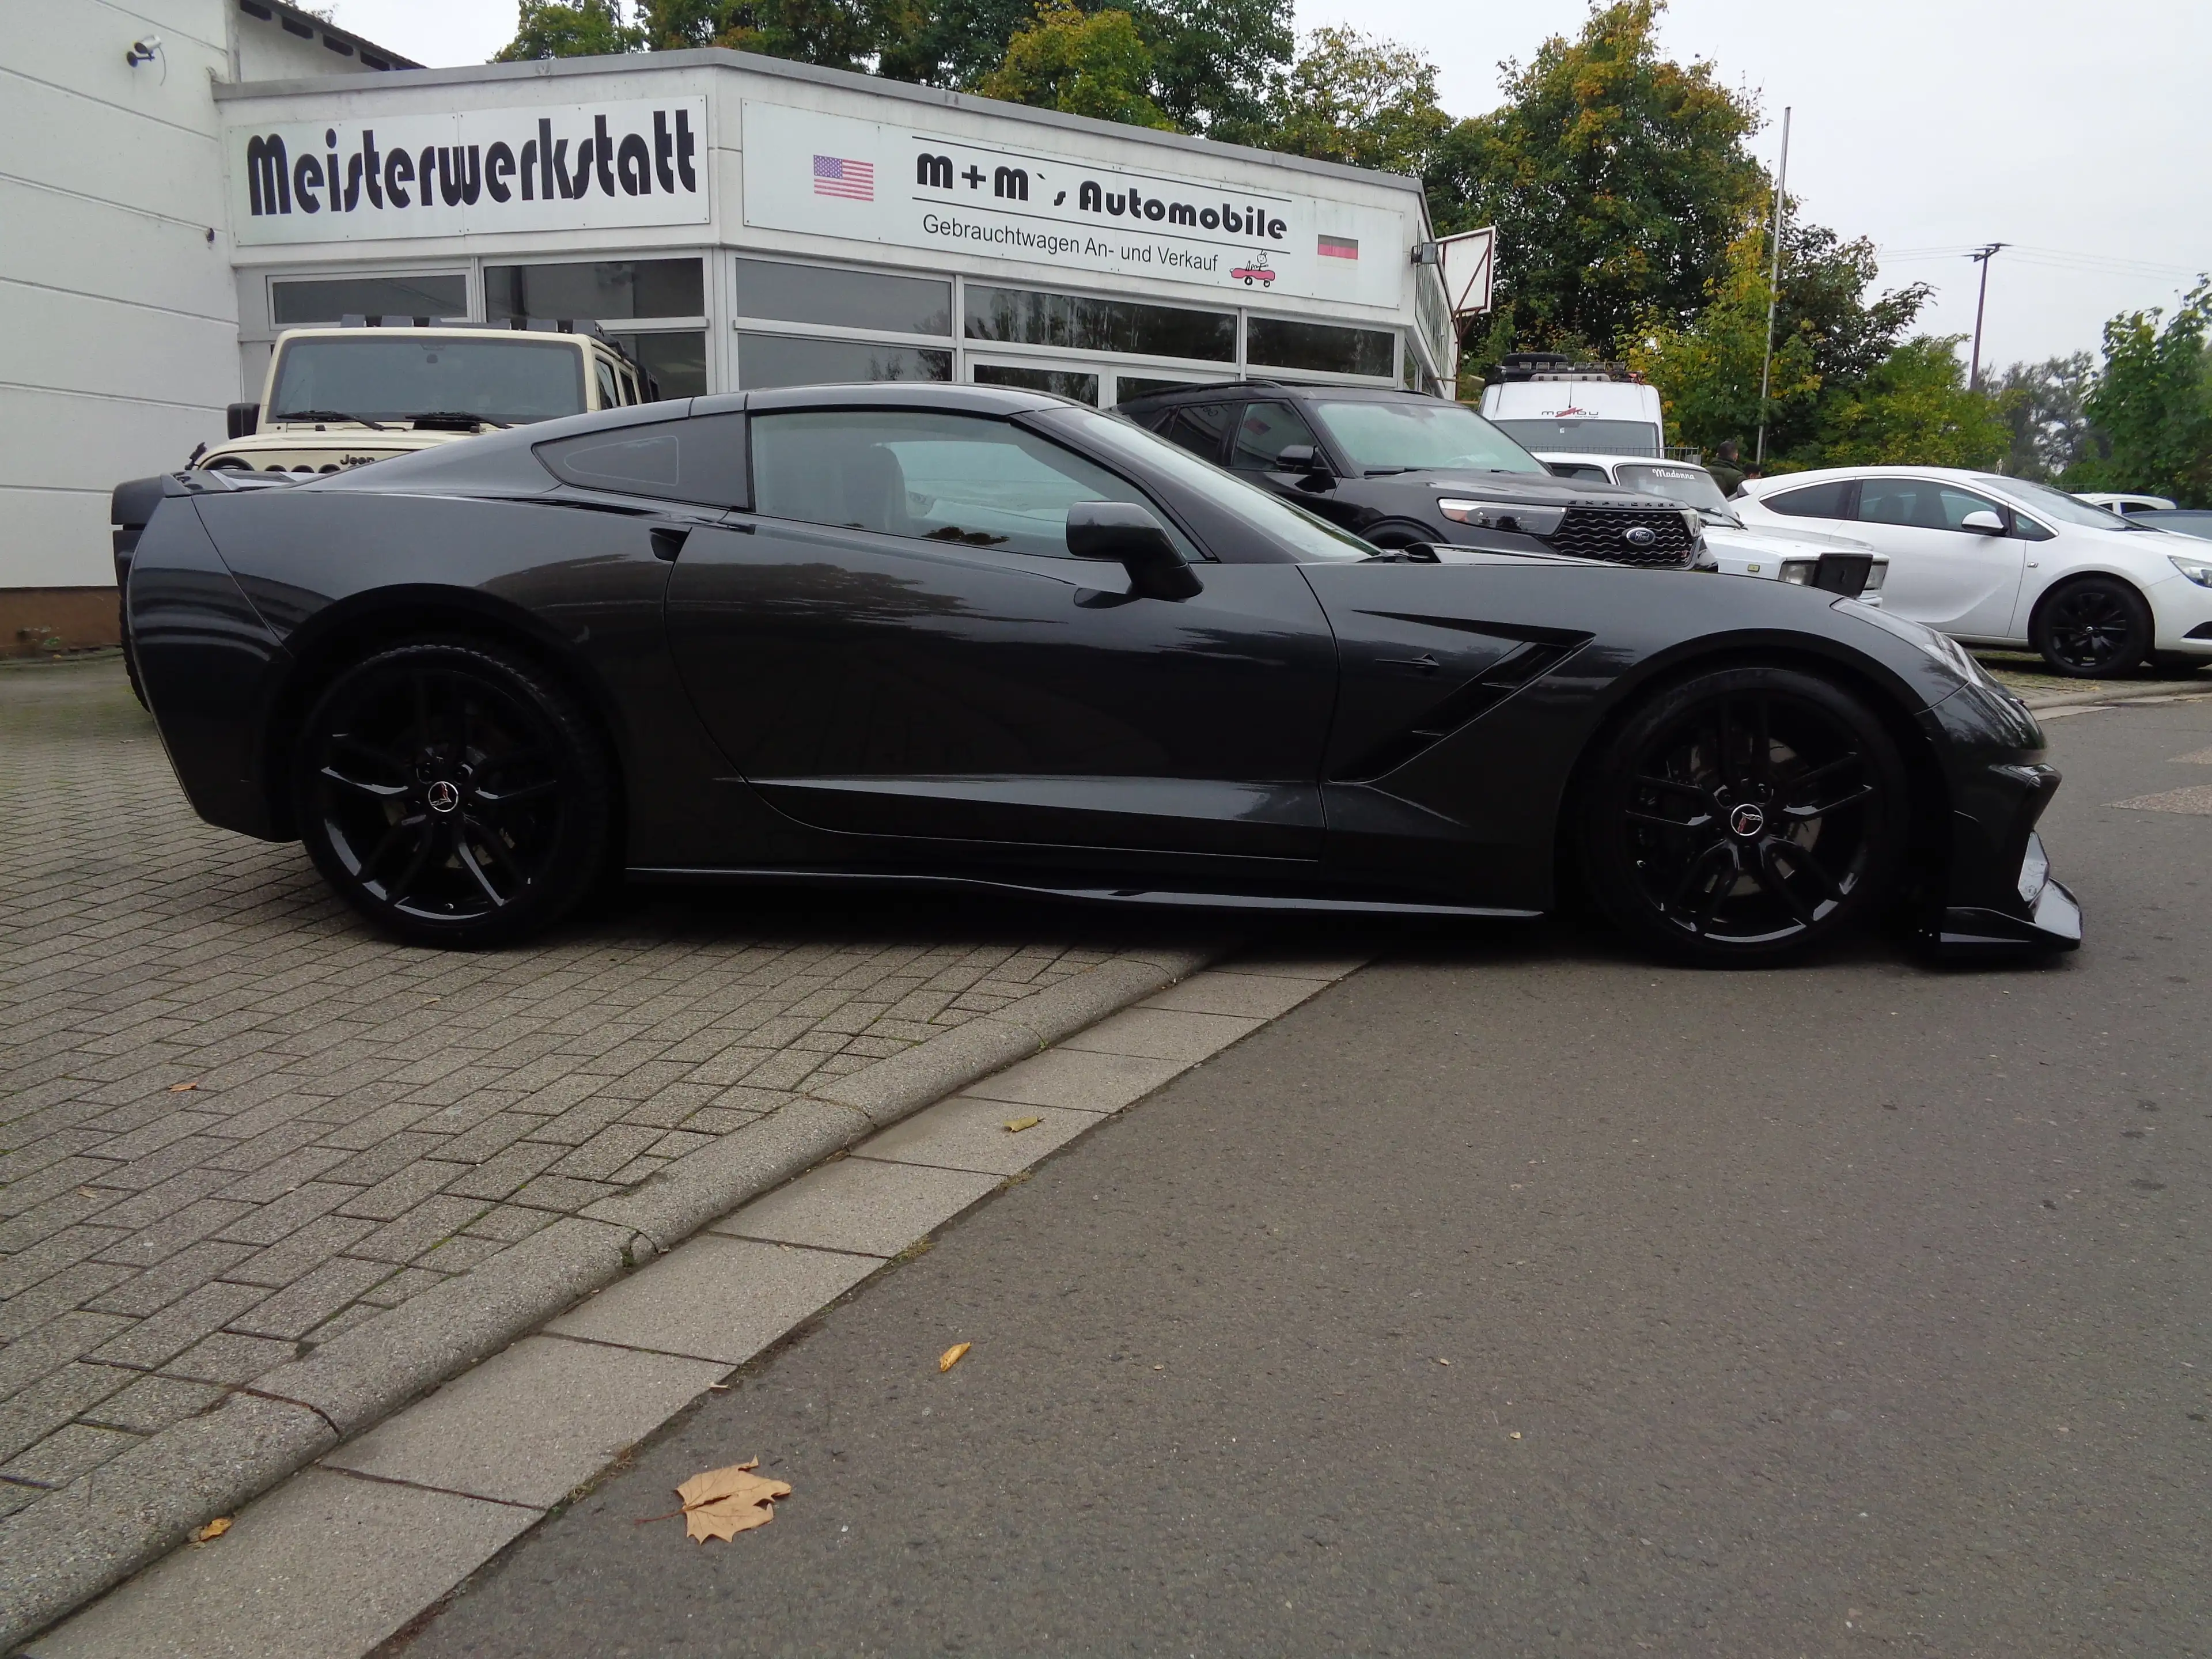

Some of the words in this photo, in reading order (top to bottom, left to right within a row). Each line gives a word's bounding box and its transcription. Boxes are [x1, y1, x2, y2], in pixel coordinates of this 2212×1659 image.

[247, 108, 696, 216] Meisterwerkstatt
[1079, 180, 1287, 240] Automobile
[922, 214, 1080, 255] Gebrauchtwagen
[1084, 237, 1115, 257] An-
[1120, 245, 1152, 263] und
[1157, 245, 1218, 272] Verkauf
[1652, 468, 1696, 480] Madonna
[1567, 499, 1676, 507] EXPLORER
[1634, 531, 1650, 541] Ford
